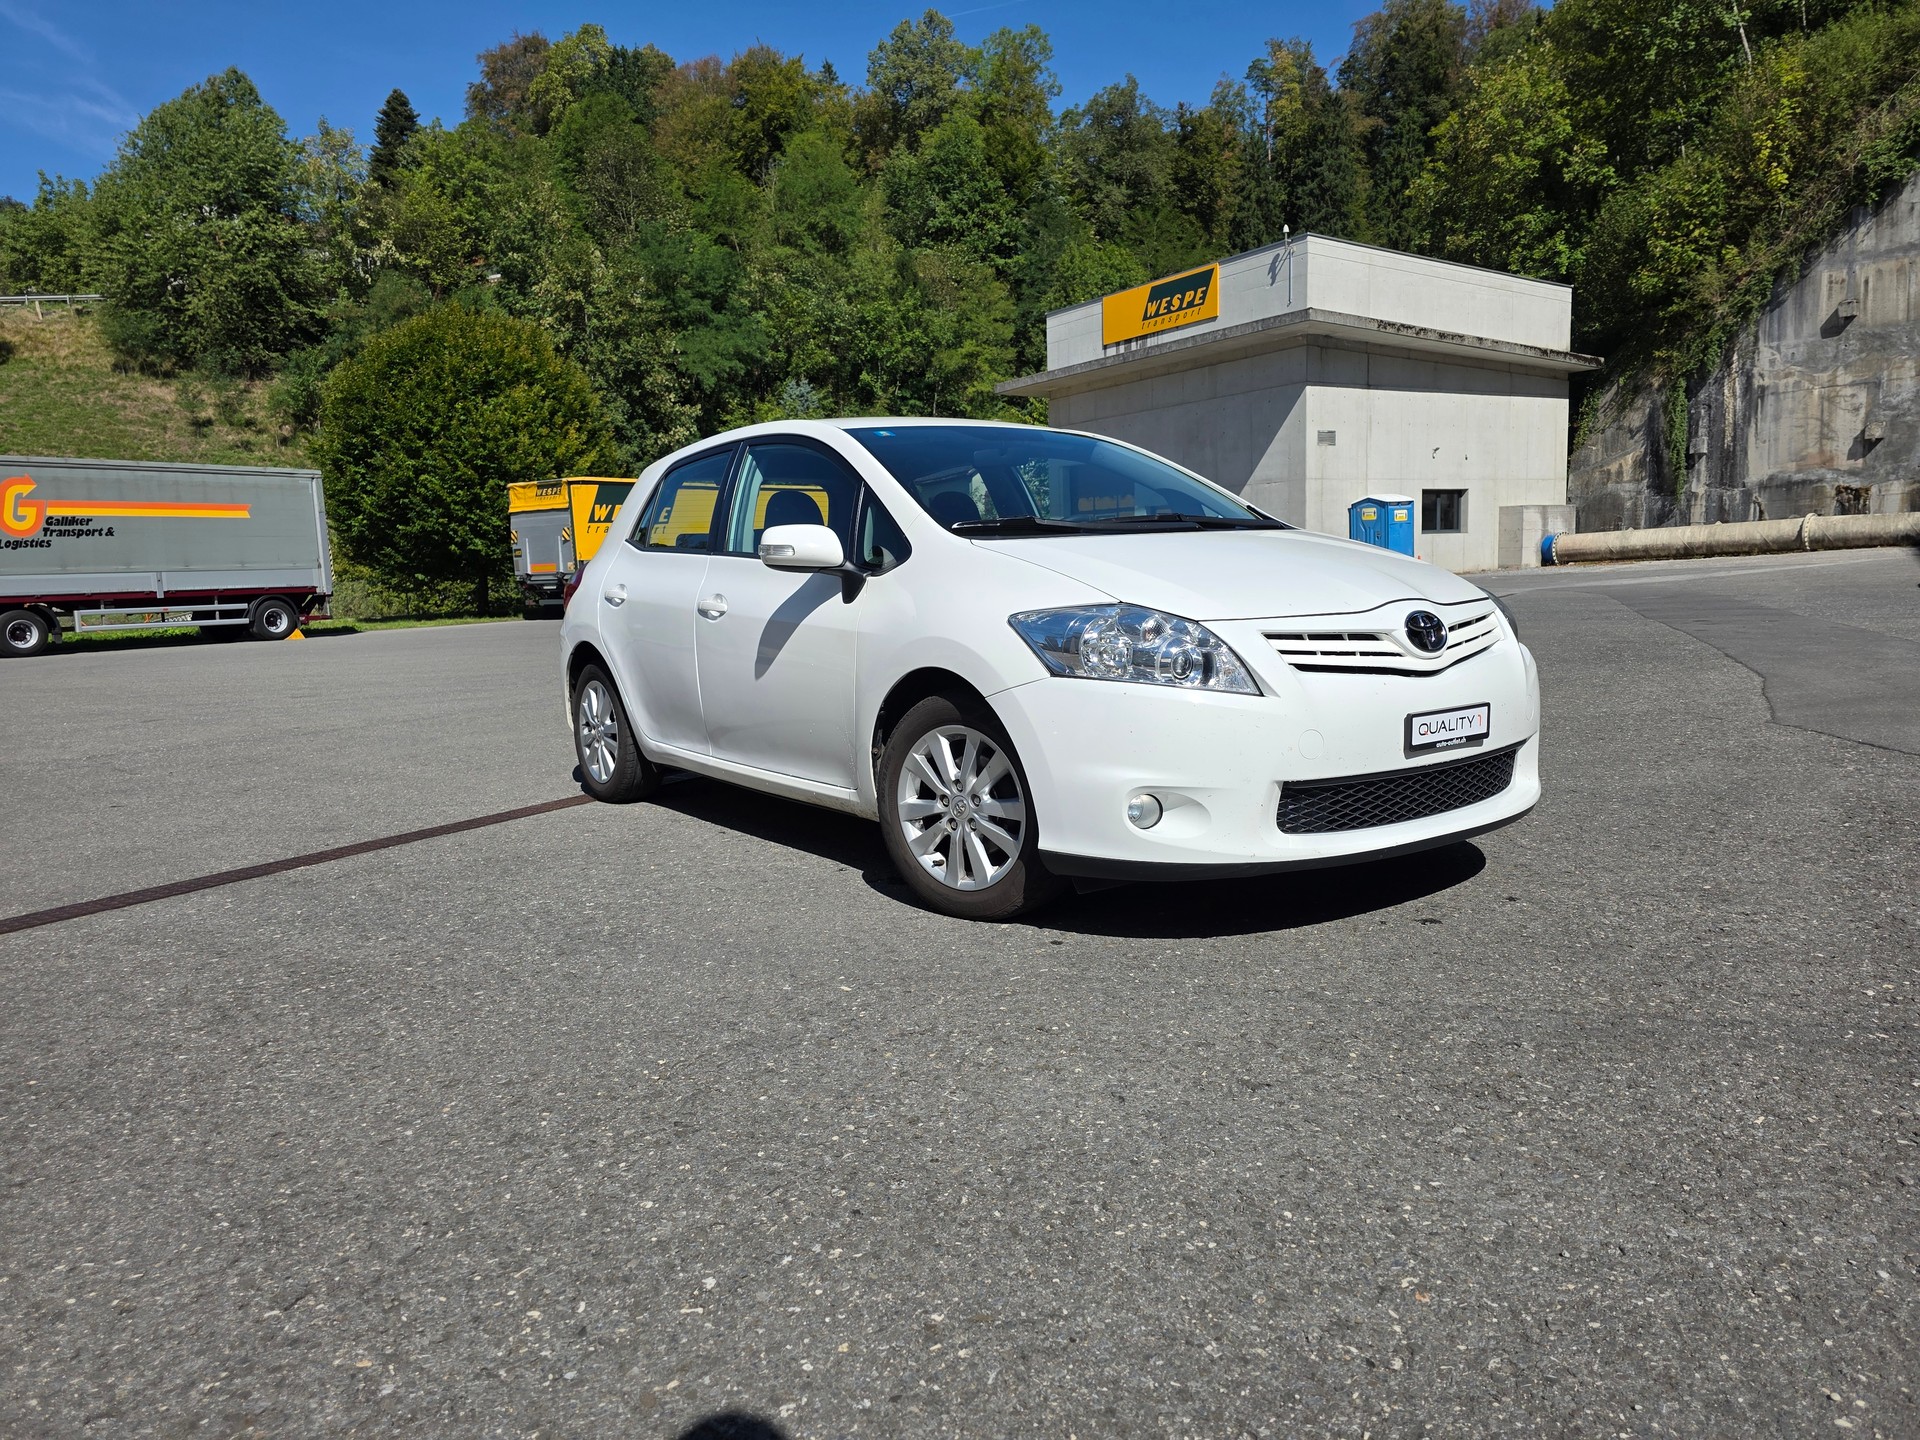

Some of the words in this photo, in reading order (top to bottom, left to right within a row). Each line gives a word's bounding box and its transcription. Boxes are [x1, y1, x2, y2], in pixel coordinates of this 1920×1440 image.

[1146, 286, 1207, 318] WESPE
[1141, 306, 1202, 330] transport
[536, 486, 561, 496] WESPE
[45, 516, 93, 527] Galliker
[42, 527, 103, 539] Transport
[105, 526, 115, 537] &
[0, 537, 52, 551] Logistics
[1418, 714, 1476, 736] QUALITY
